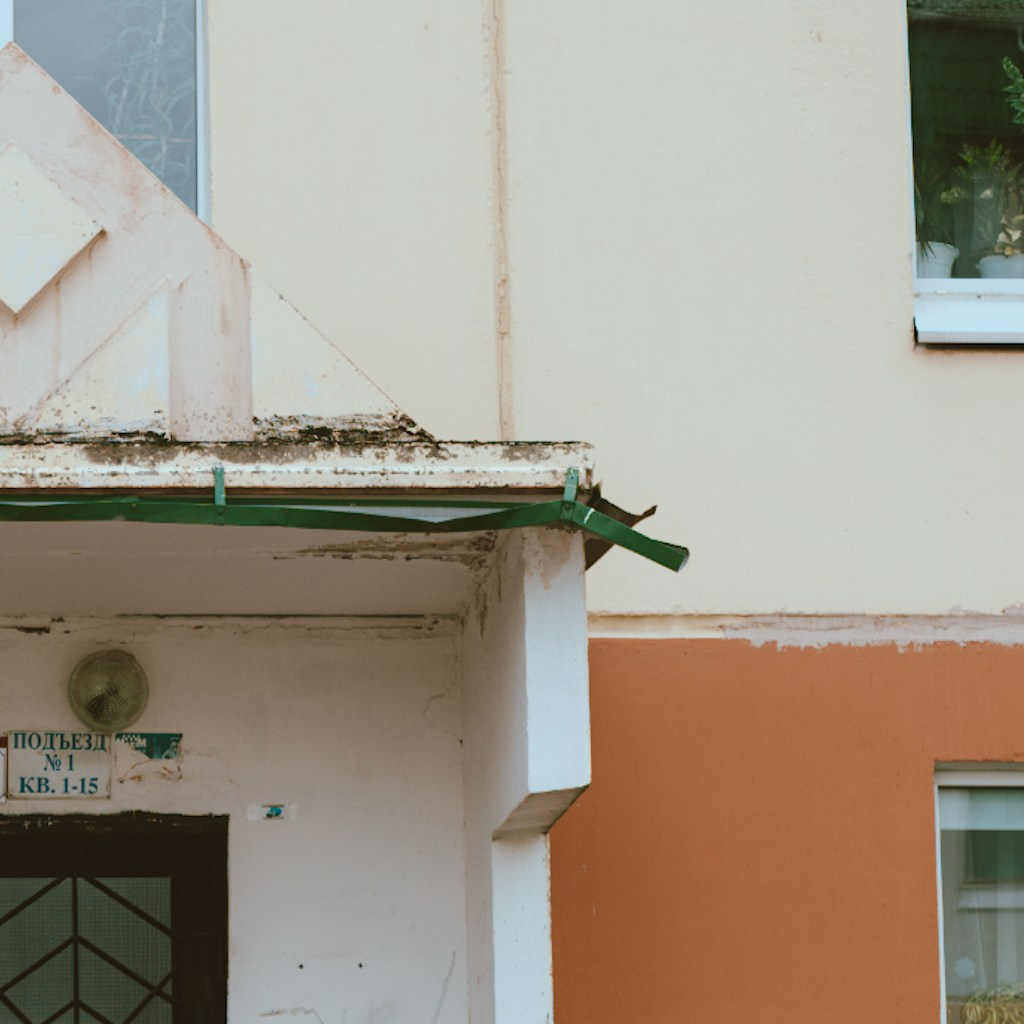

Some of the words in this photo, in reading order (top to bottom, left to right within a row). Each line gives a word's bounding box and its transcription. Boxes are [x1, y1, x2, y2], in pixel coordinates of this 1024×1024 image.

[13, 733, 107, 752] ПОДЪЕЗД
[43, 754, 61, 771] №
[67, 754, 74, 771] 1
[19, 777, 56, 794] КВ.
[62, 777, 99, 795] 1-15
